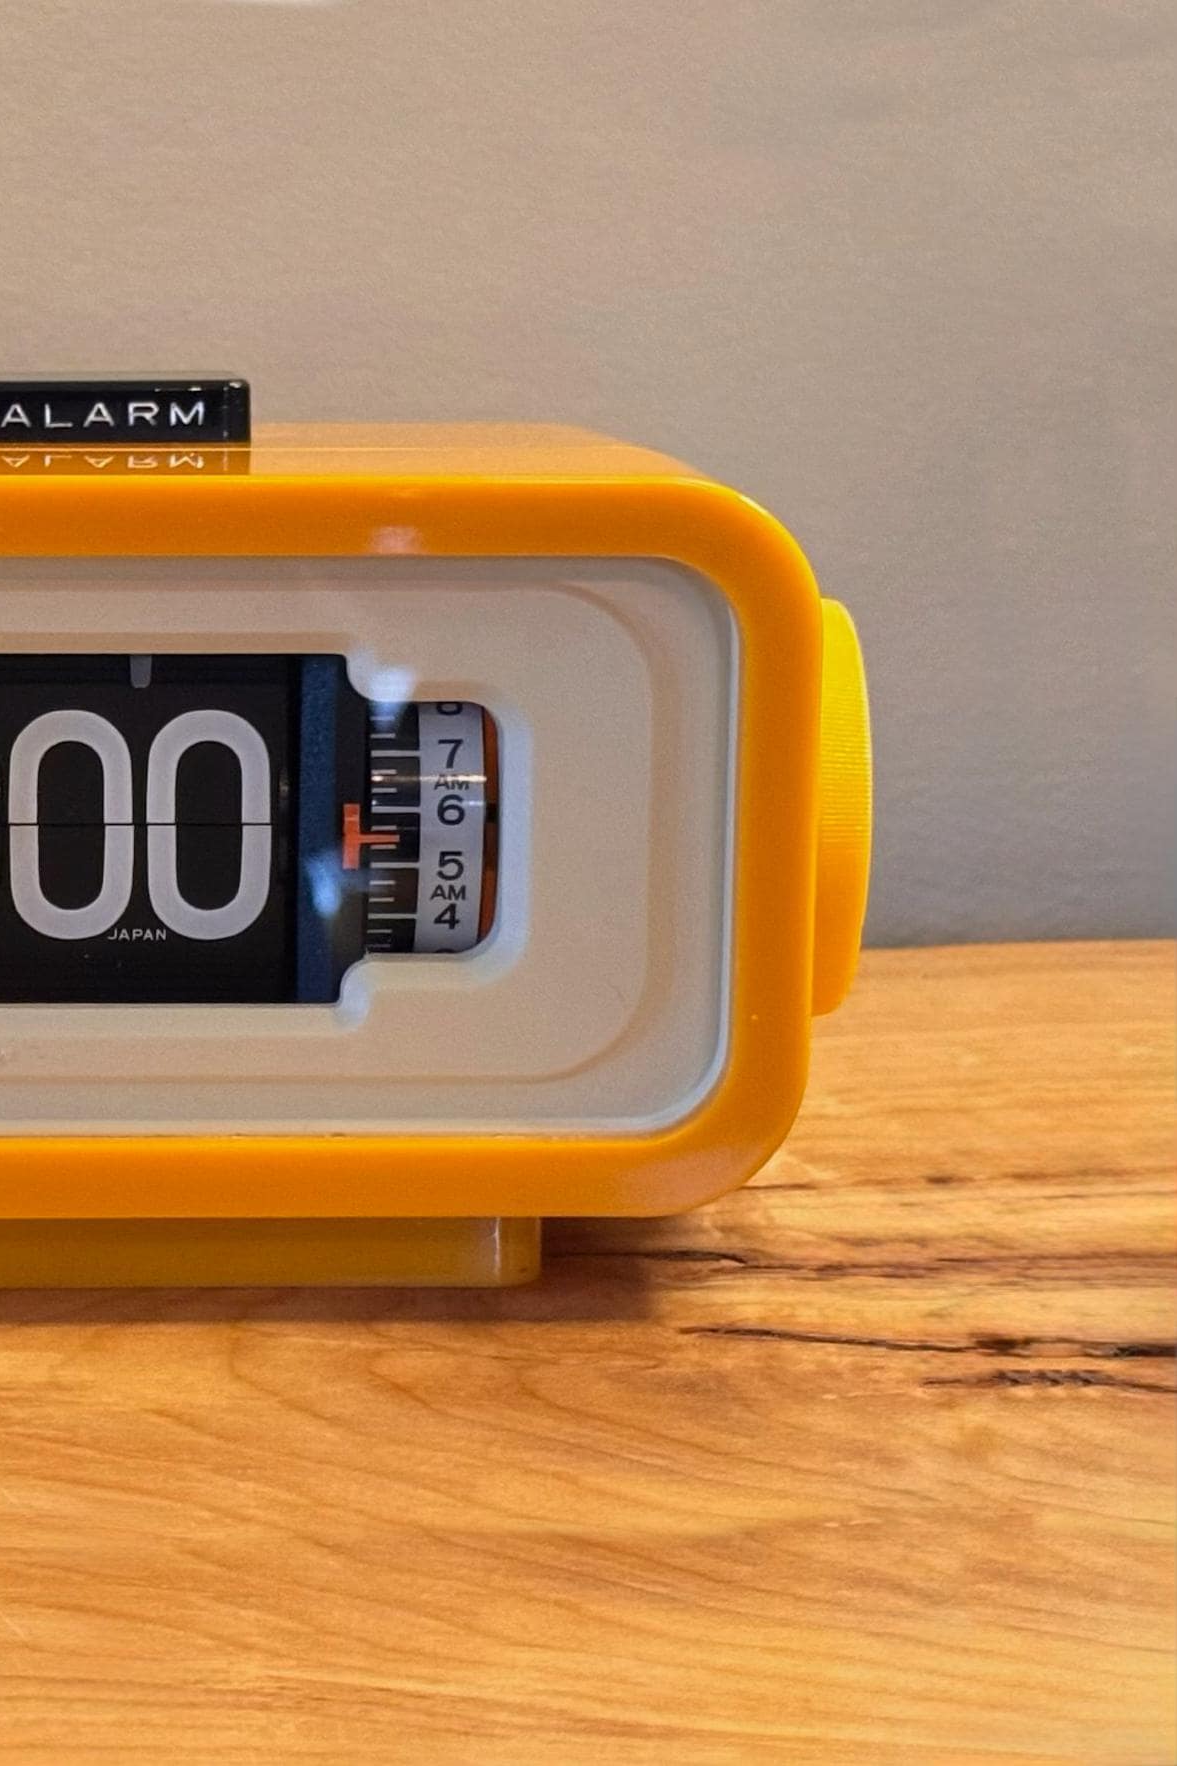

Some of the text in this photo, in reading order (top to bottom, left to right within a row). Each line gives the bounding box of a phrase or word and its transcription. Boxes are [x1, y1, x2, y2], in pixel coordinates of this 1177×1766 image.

[1, 401, 205, 428] ALARM
[438, 739, 464, 768] 7
[434, 773, 470, 790] AM
[437, 795, 465, 825] 6
[8, 709, 271, 940] 00
[436, 851, 464, 881] 5
[430, 885, 466, 900] AM
[433, 903, 460, 929] 4
[107, 928, 167, 941] JAPAN
